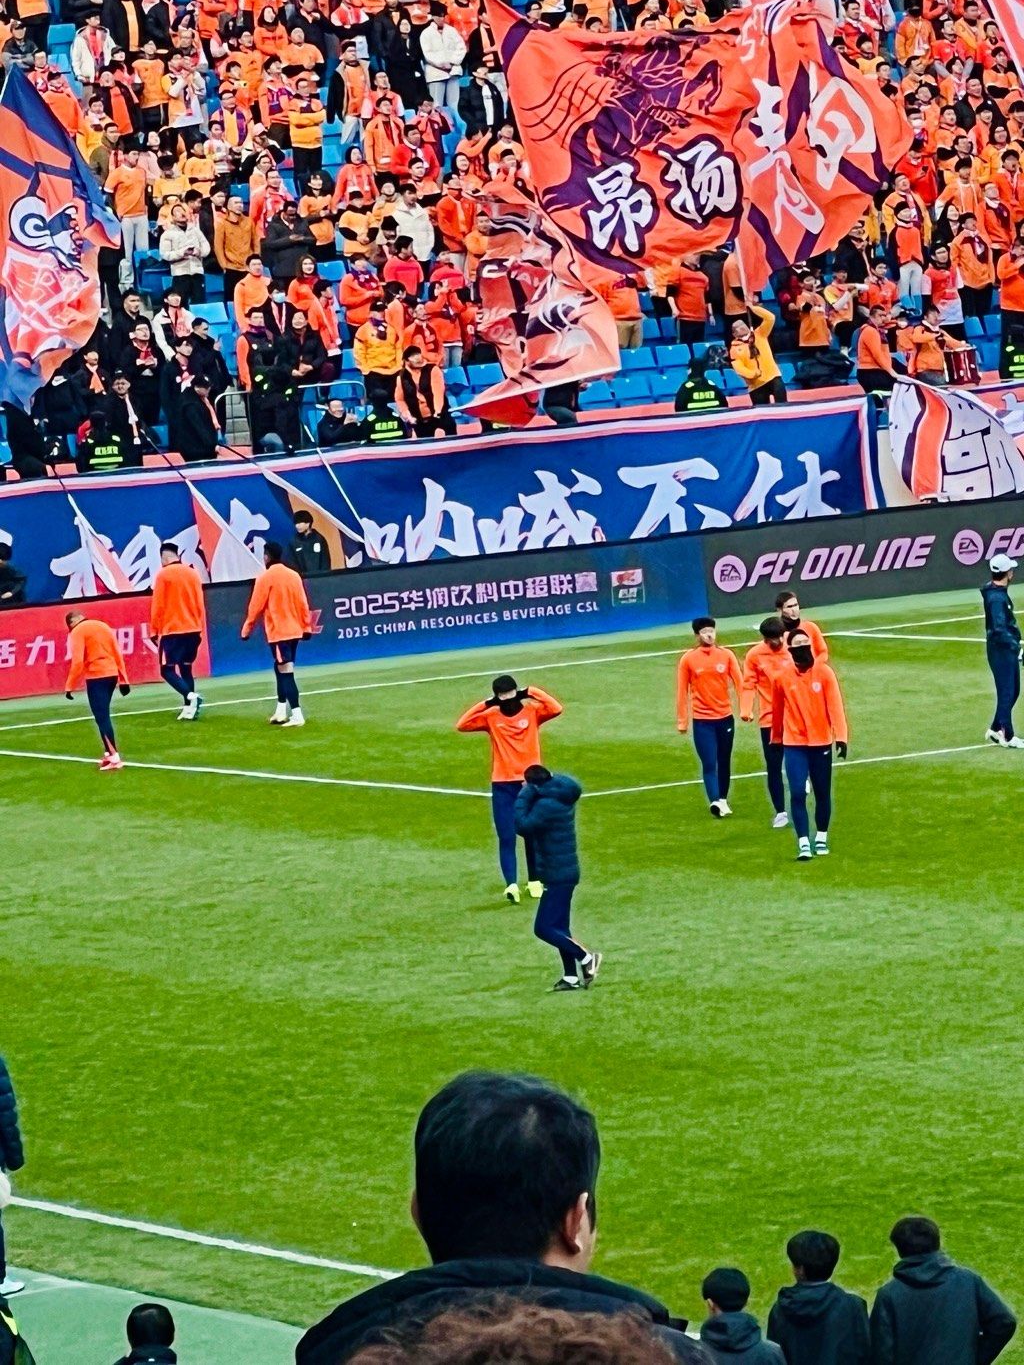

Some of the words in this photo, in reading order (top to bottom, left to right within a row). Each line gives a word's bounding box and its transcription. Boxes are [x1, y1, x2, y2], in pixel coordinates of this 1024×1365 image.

[747, 550, 800, 587] FC
[800, 535, 937, 581] ONLINE
[337, 625, 370, 640] 2025
[374, 620, 417, 635] CHINA
[421, 611, 499, 630] RESOURCES
[502, 603, 572, 622] BEVERAGE
[576, 600, 600, 613] CSL
